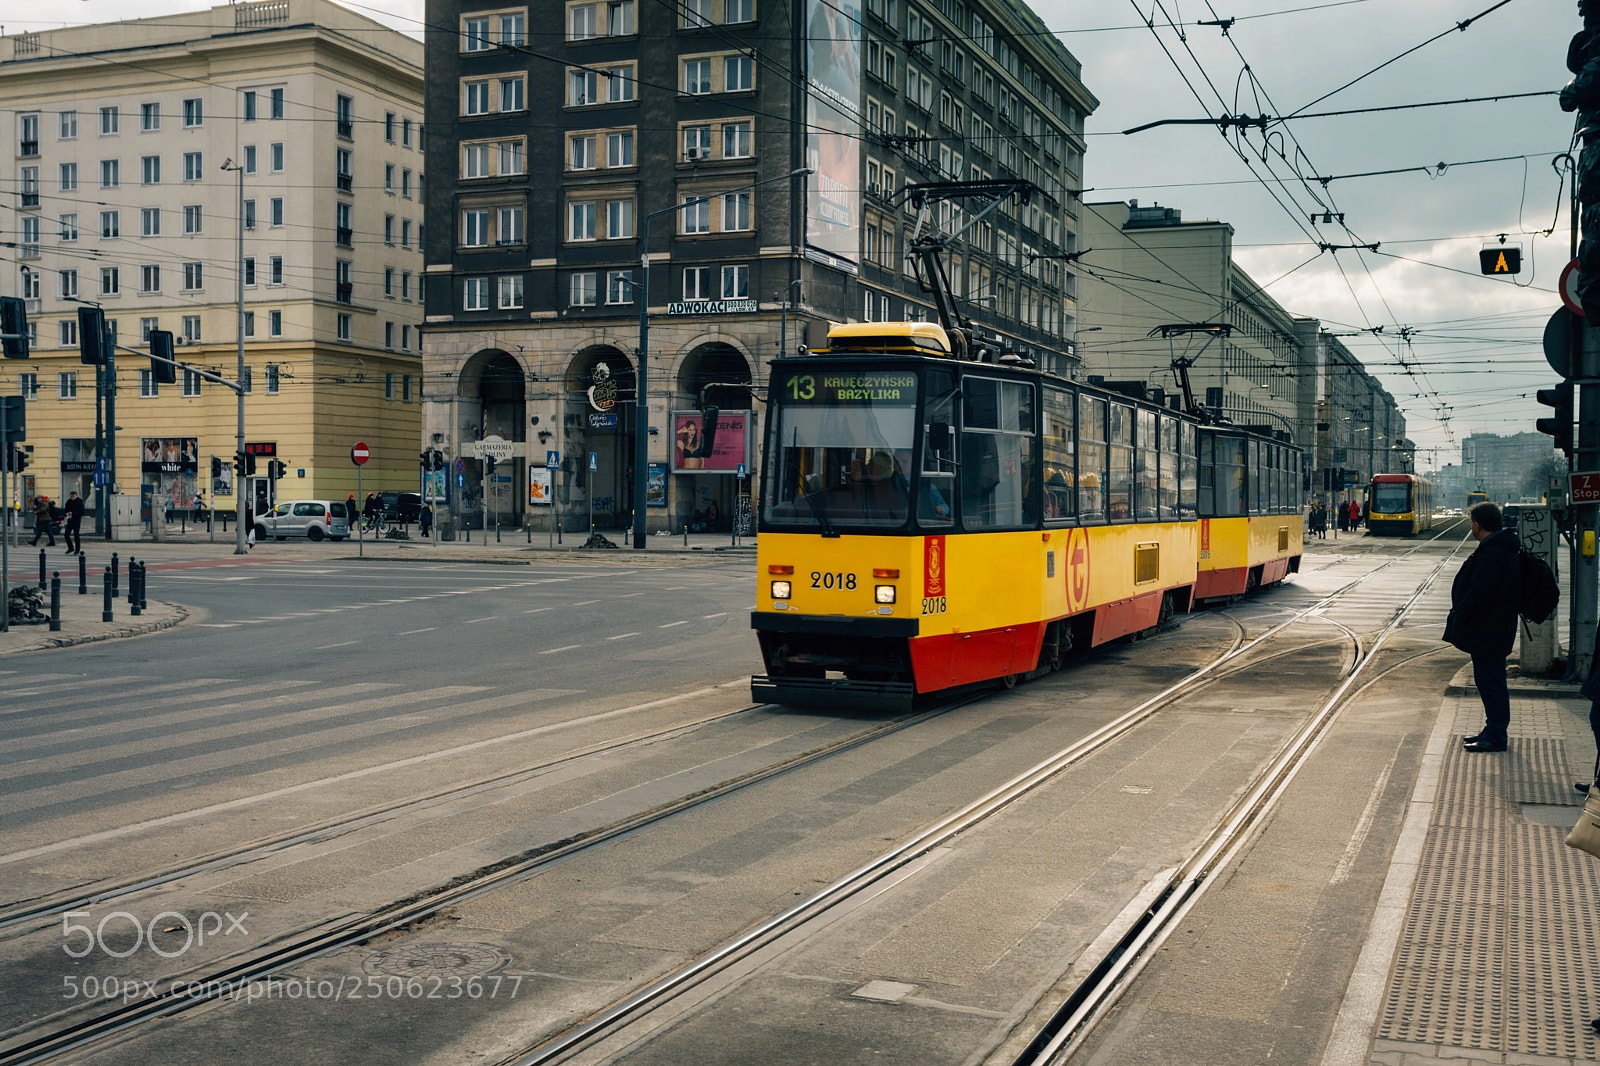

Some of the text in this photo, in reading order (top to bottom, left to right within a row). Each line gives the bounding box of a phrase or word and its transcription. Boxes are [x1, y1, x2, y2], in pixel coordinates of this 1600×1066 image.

[668, 301, 728, 314] ADWOKACI
[786, 375, 816, 400] 13
[838, 389, 900, 400] BAZYLIKA
[161, 462, 182, 472] white
[1574, 489, 1600, 500] Stop
[810, 571, 858, 590] 2018
[921, 596, 947, 616] 2018
